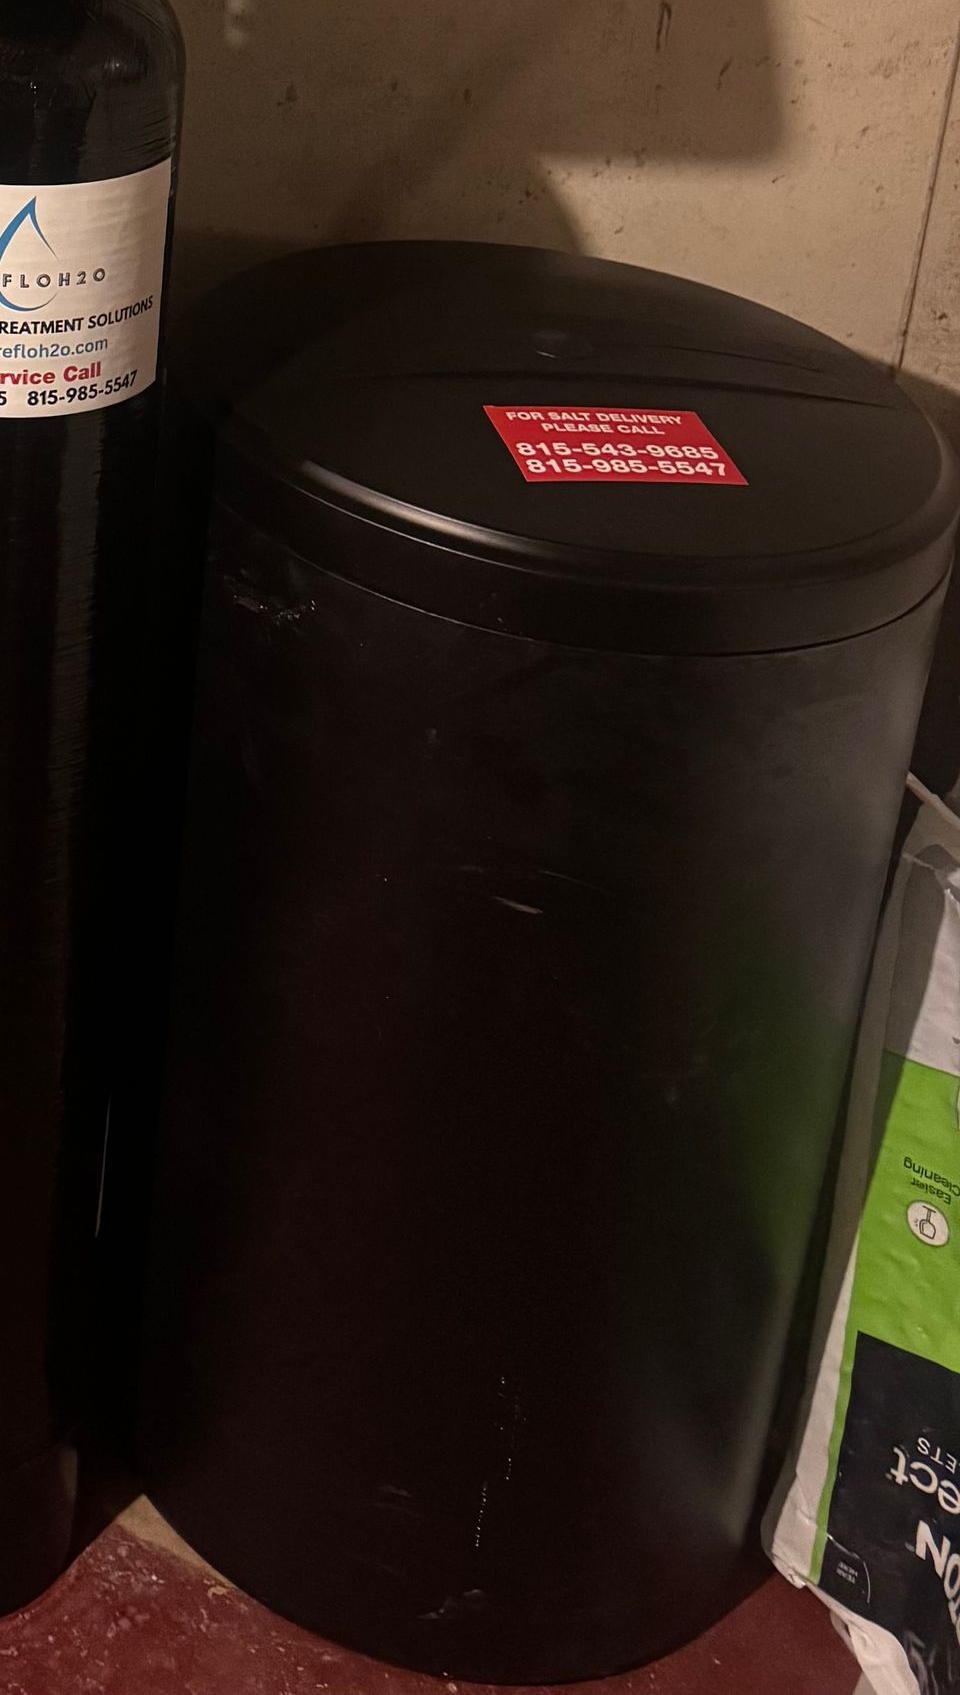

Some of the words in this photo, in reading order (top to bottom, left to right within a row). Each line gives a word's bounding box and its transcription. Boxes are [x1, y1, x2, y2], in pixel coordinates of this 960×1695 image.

[87, 295, 153, 329] SOLUTIONS
[63, 361, 101, 383] Call
[26, 369, 138, 406] 815-985-5547
[505, 410, 544, 421] FOR
[547, 412, 591, 423] SALT
[595, 413, 683, 426] DELIVERY
[542, 422, 614, 434] PLEASE
[616, 424, 666, 435] CALL
[515, 442, 719, 460] 815-543-9685
[526, 459, 726, 477] 815-985-5547
[903, 1156, 960, 1197] Cleaning
[910, 1177, 952, 1205] Easier
